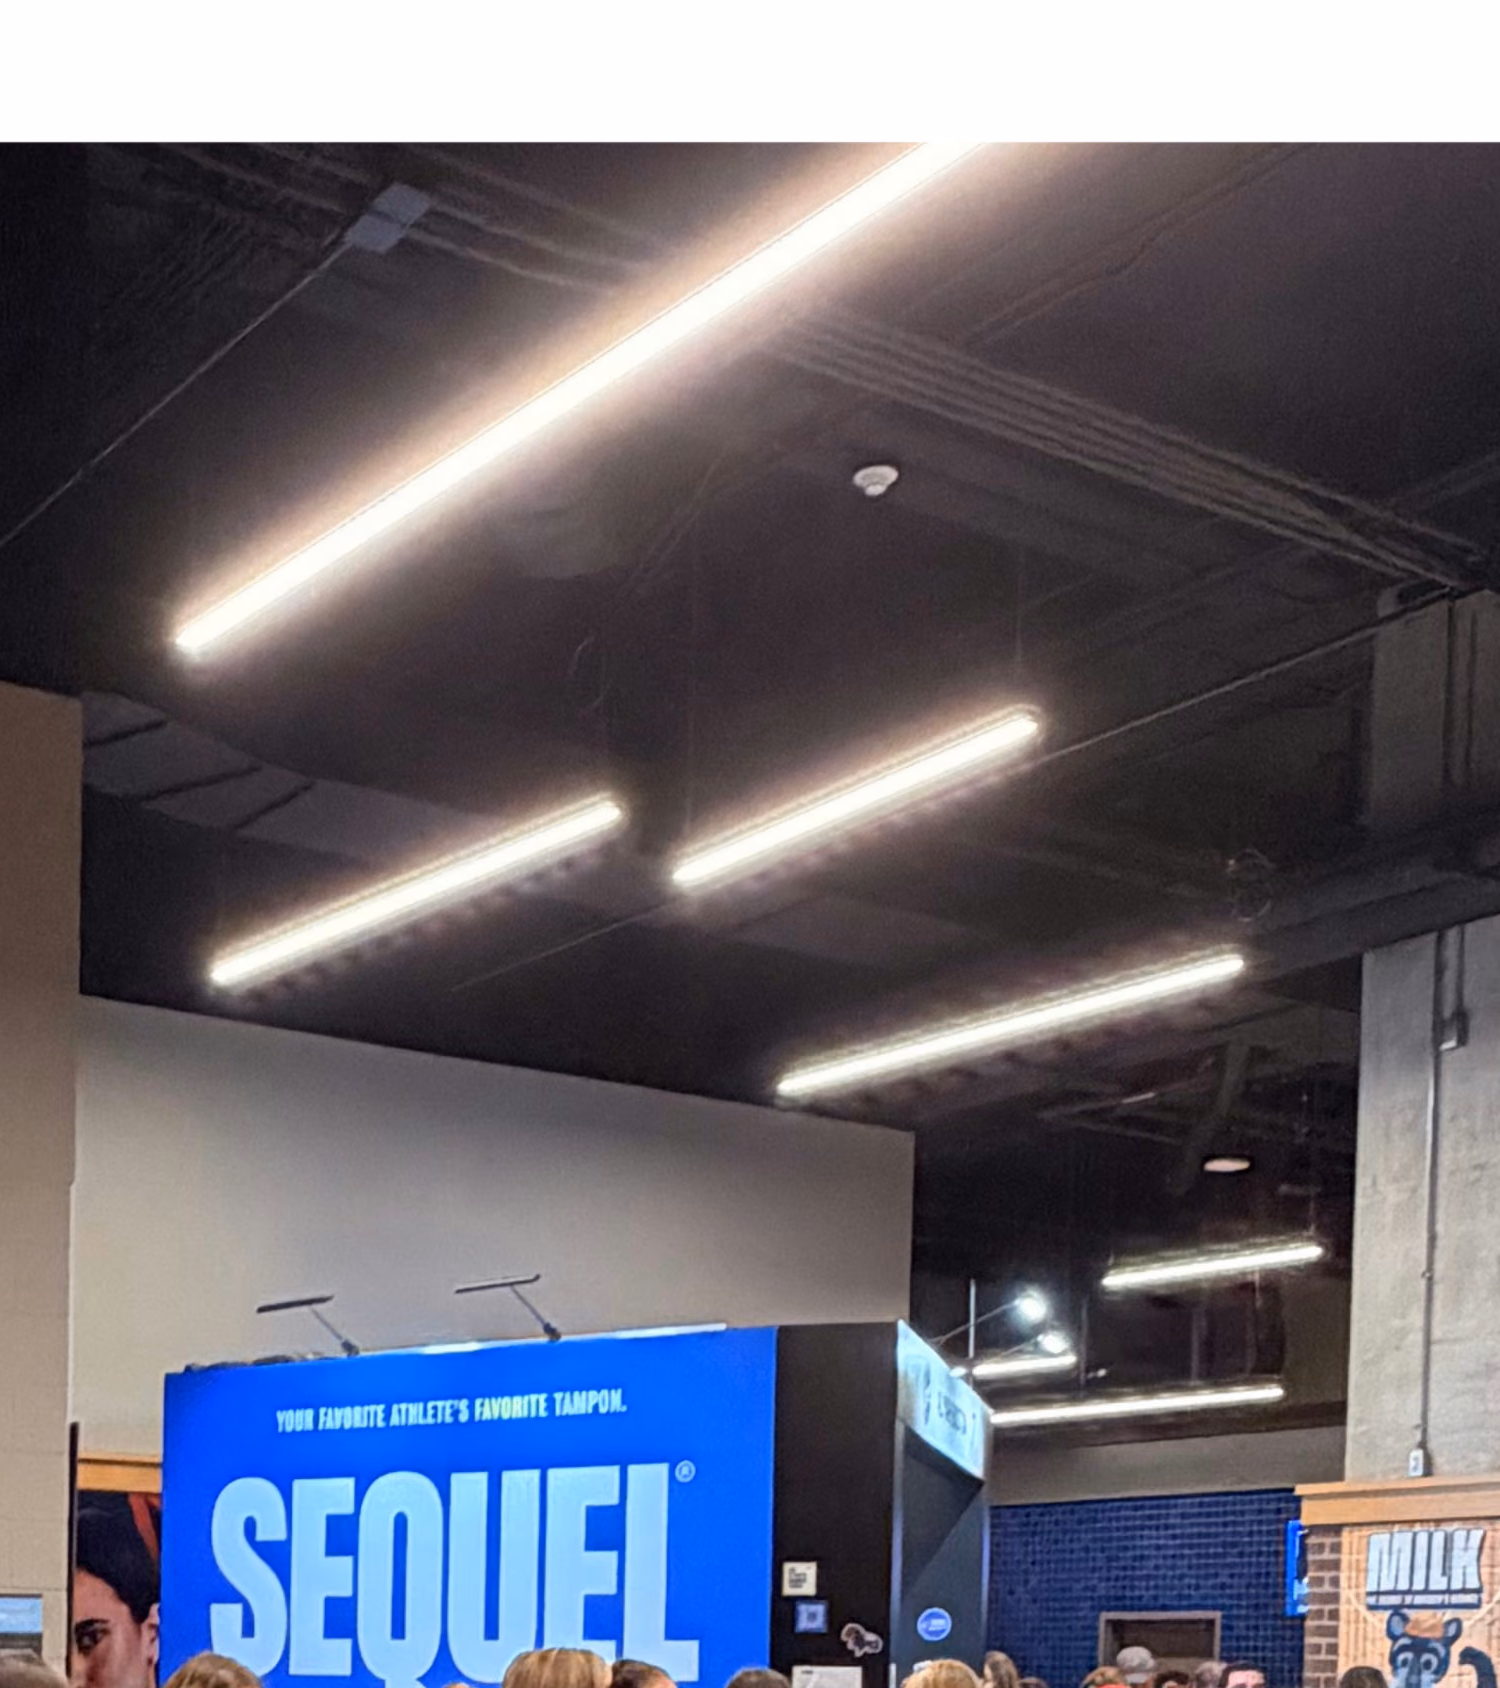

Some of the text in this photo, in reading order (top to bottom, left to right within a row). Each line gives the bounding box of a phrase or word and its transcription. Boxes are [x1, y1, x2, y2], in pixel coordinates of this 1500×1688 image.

[276, 1409, 314, 1433] YOUR
[317, 1404, 385, 1431] FAVORITE
[389, 1398, 469, 1428] ATHLETE'S
[474, 1393, 548, 1422] FAVORITE
[1366, 1528, 1485, 1592] MILK
